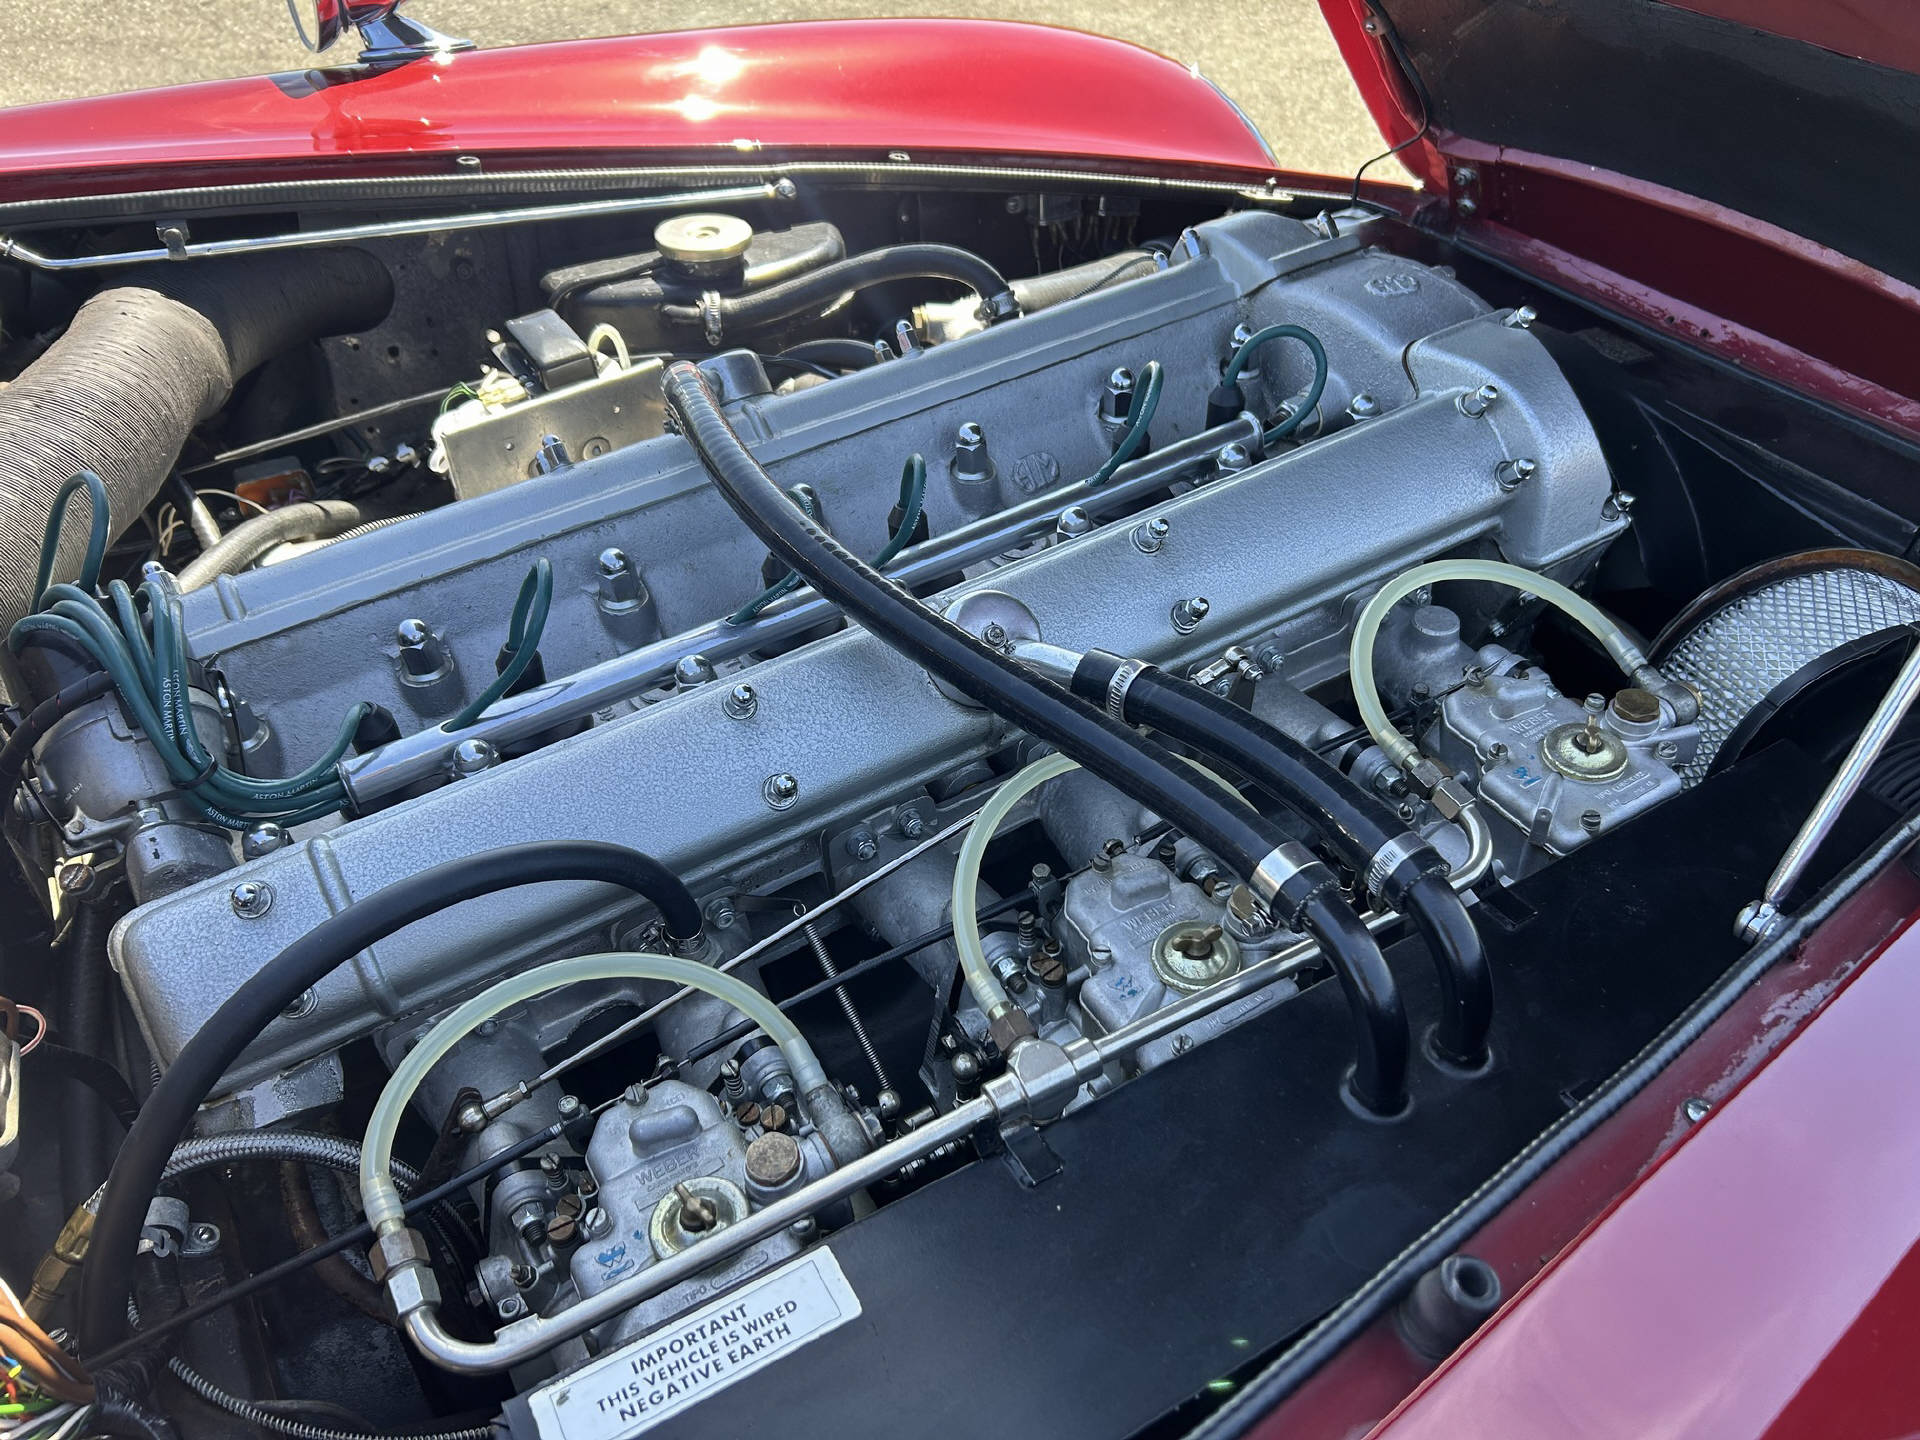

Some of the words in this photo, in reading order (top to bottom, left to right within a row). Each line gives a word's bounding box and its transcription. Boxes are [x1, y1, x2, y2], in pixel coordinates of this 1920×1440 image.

[162, 677, 172, 708] ASTON
[174, 699, 188, 736] MARTIN
[1508, 709, 1555, 734] WEBER
[252, 792, 283, 800] ASTON
[207, 806, 229, 823] ASTON
[227, 819, 250, 829] MART
[635, 1145, 700, 1186] WEBER
[596, 1381, 641, 1413] THIS
[642, 1341, 720, 1387] VEHICLE
[721, 1330, 740, 1347] IS
[741, 1299, 798, 1336] WIRED
[630, 1303, 748, 1375] IMPORTANT
[618, 1357, 724, 1422] NEGATIVE
[727, 1322, 792, 1366] EARTH
